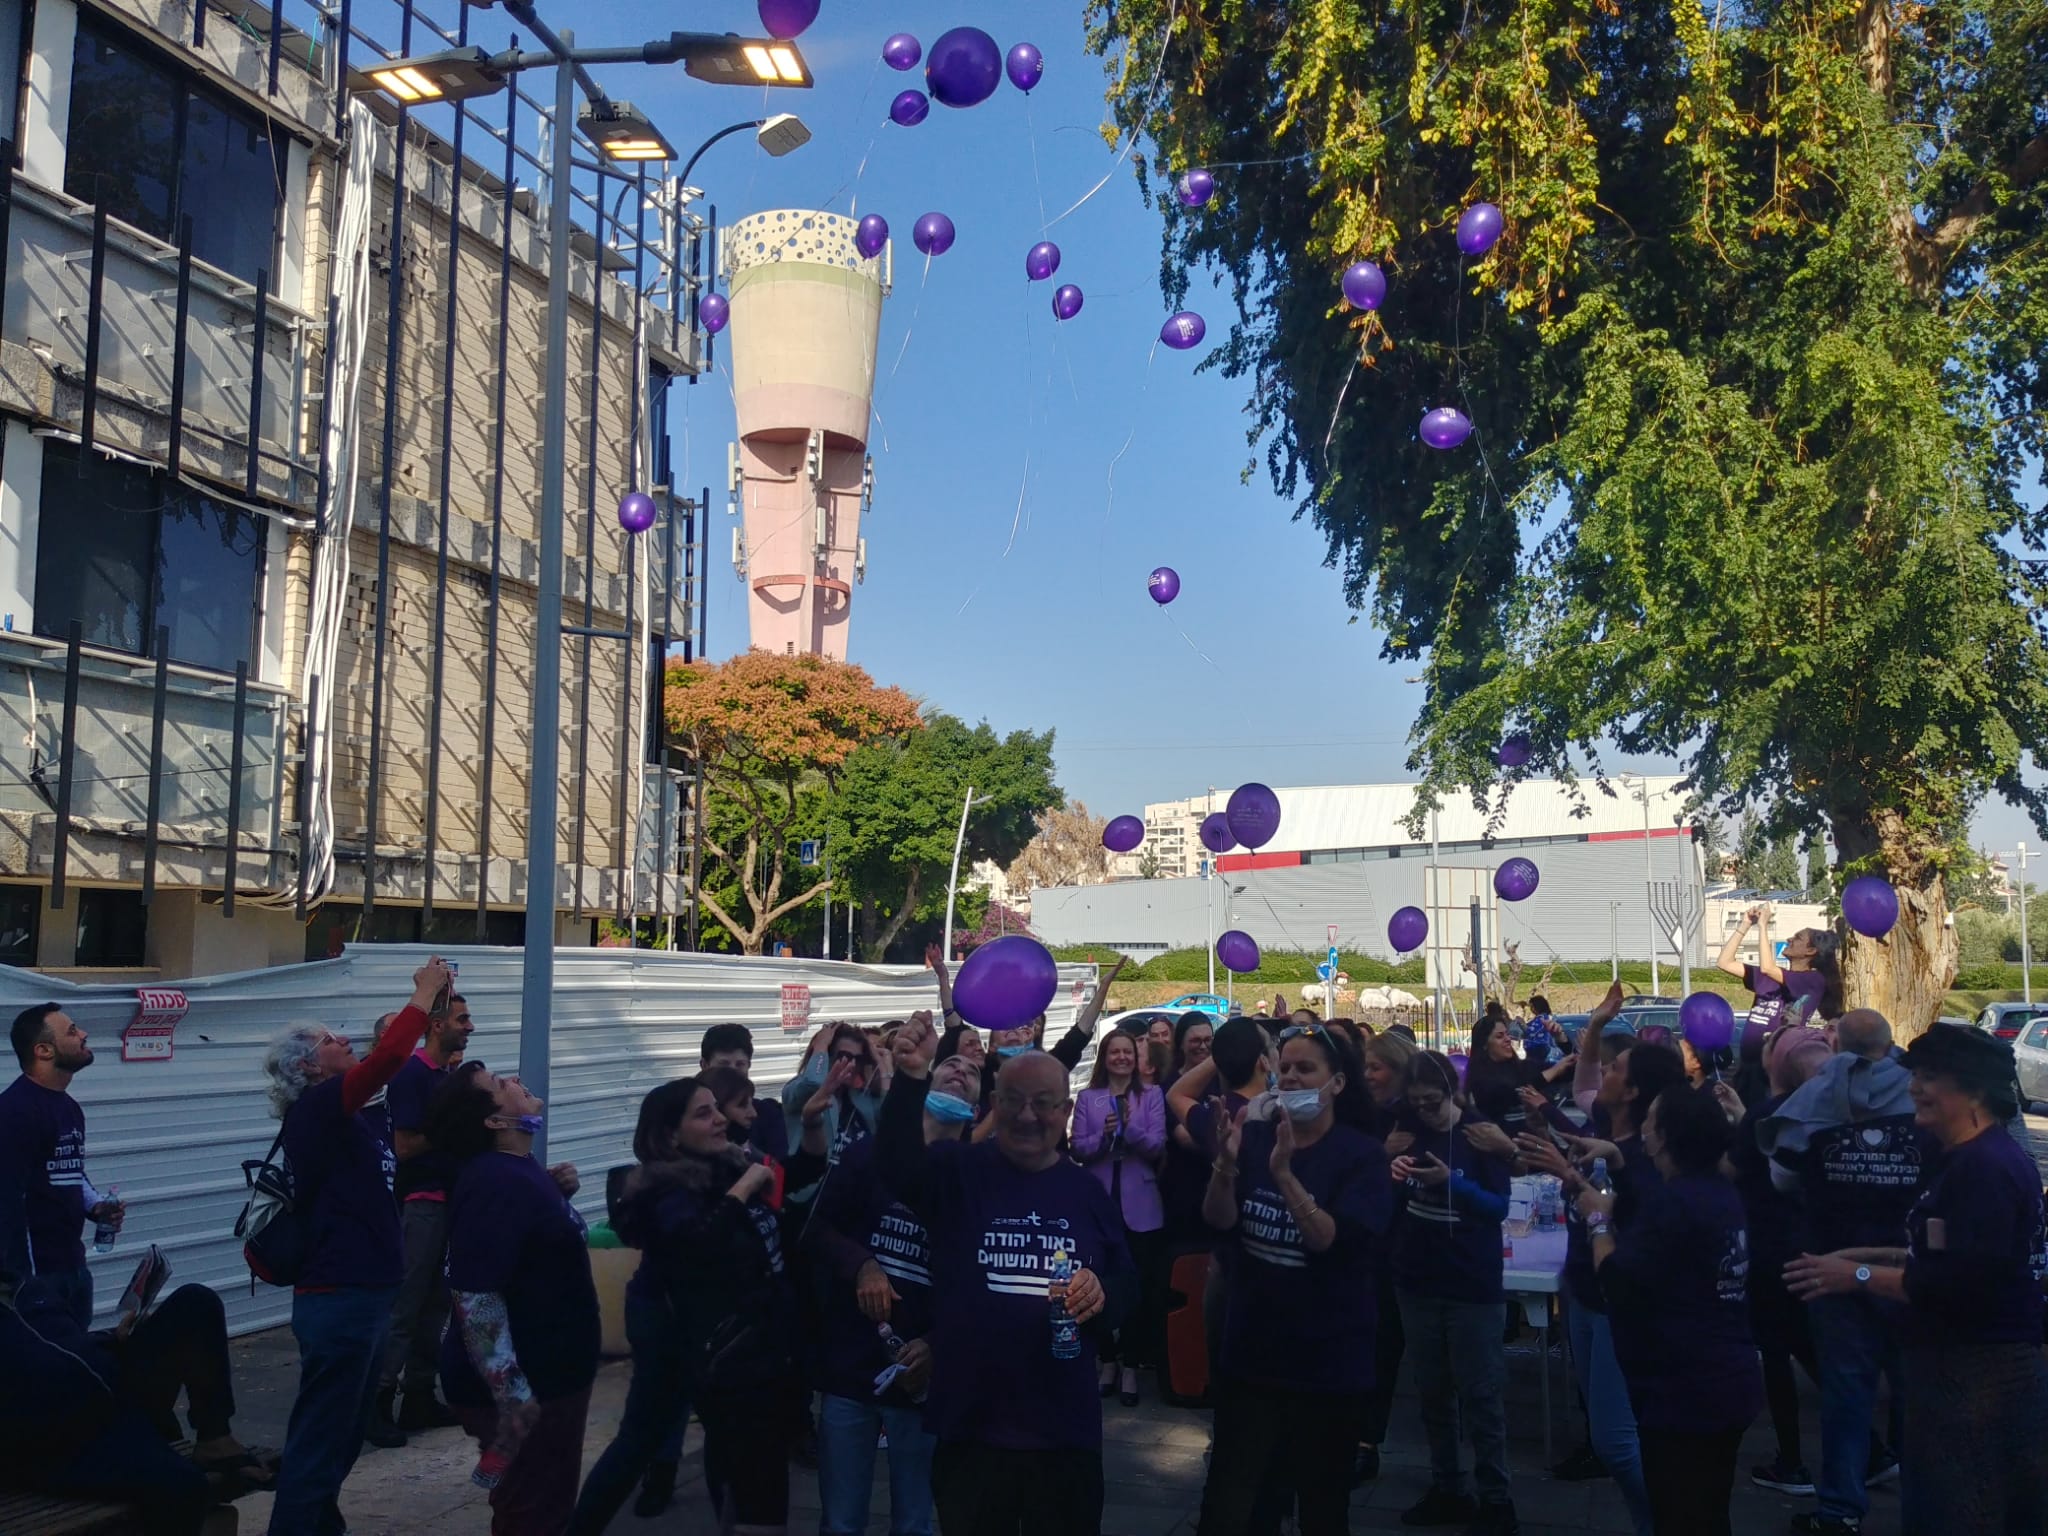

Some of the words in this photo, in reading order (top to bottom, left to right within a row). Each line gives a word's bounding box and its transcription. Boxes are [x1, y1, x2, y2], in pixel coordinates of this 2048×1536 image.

[141, 991, 186, 1009] סכנה!
[1243, 1199, 1282, 1222] יהודה
[879, 1215, 919, 1237] יהודה
[870, 1232, 921, 1259] תושווים
[984, 1231, 1031, 1248] יהודה
[1036, 1233, 1076, 1253] באור
[977, 1248, 1039, 1270] תושווים
[1044, 1255, 1083, 1274] כונו
